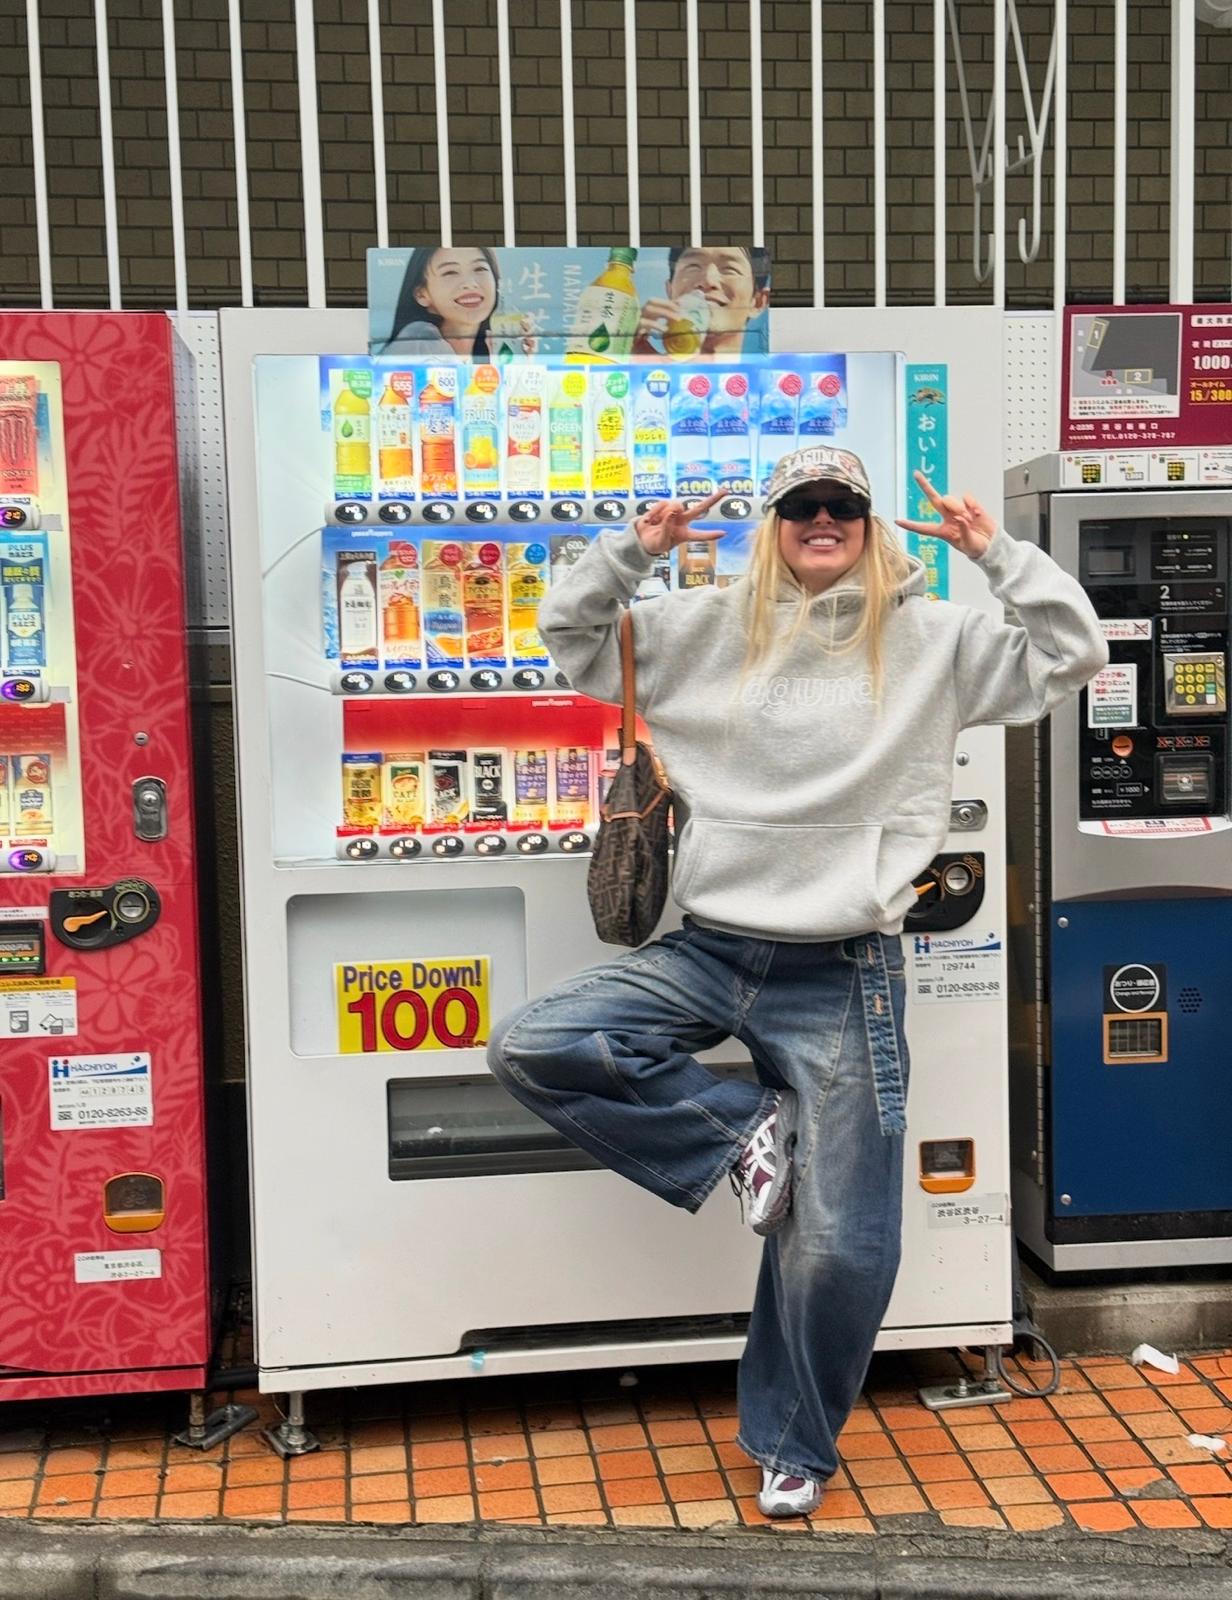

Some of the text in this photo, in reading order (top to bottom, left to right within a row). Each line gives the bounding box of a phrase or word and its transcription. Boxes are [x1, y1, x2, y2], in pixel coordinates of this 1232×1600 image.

[1134, 371, 1142, 382] 2
[1159, 585, 1170, 599] 2
[1160, 618, 1168, 632] 1
[343, 960, 482, 993] Price Down!
[347, 987, 480, 1052] 100
